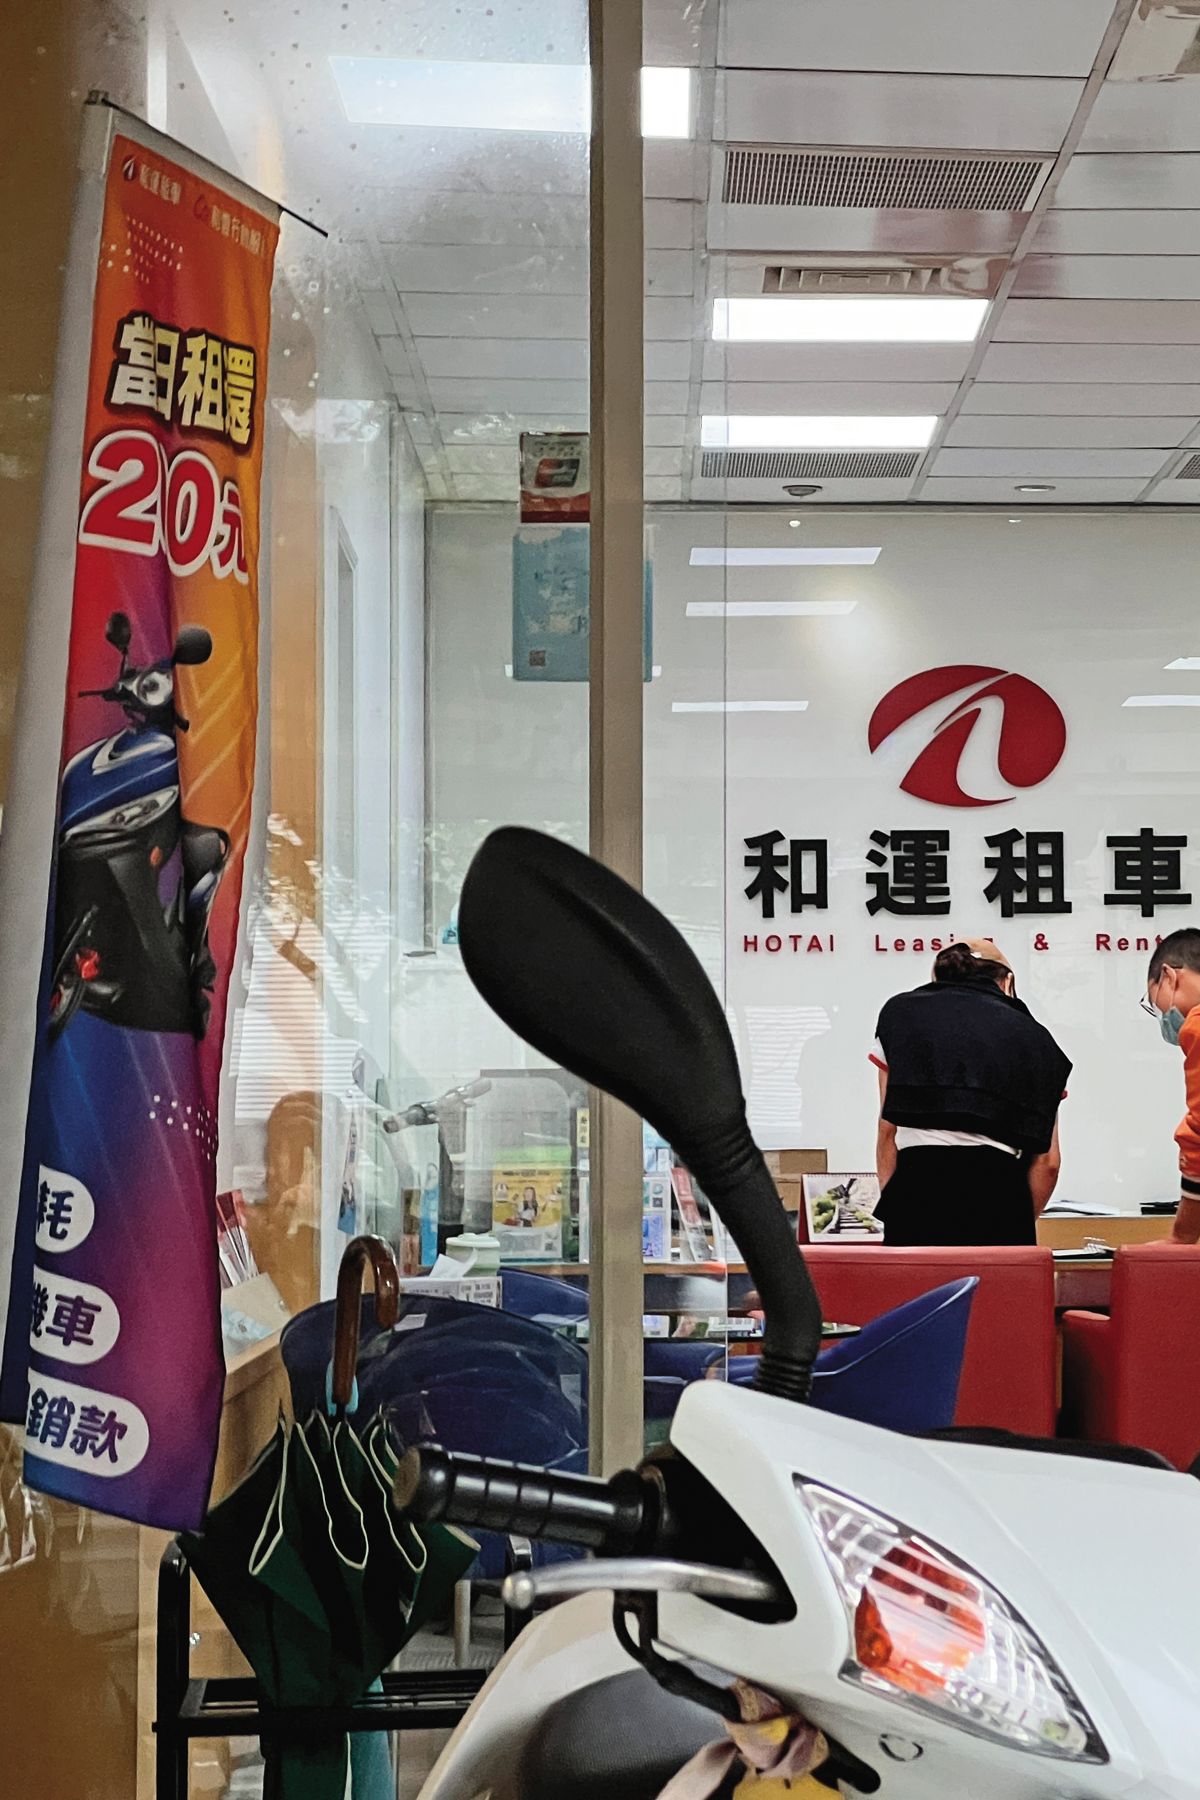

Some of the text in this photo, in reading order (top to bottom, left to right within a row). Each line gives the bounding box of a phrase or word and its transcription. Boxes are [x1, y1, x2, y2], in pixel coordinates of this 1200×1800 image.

[743, 827, 1193, 919] 和運租車
[743, 934, 835, 953] HOTAI
[874, 933, 994, 952] Leas
[1034, 933, 1050, 952] &
[26, 1387, 129, 1464] 銷款
